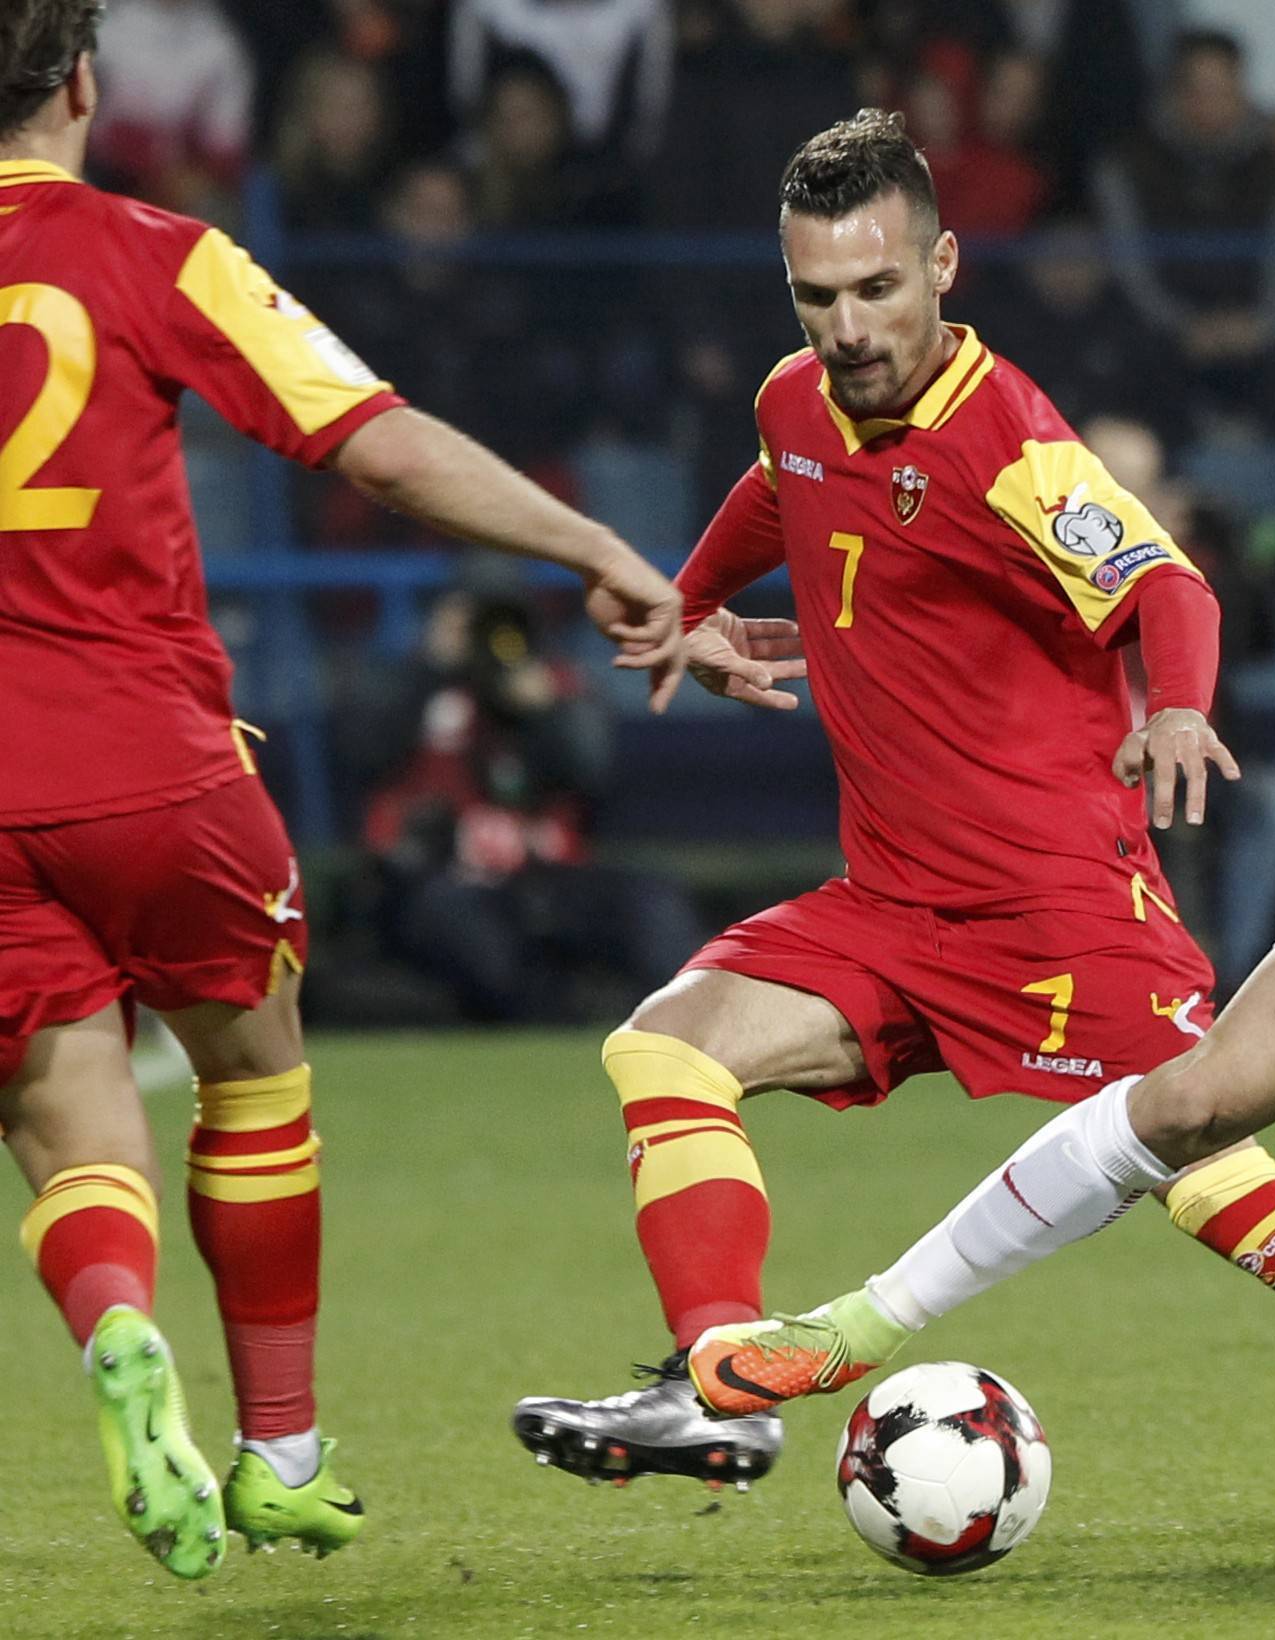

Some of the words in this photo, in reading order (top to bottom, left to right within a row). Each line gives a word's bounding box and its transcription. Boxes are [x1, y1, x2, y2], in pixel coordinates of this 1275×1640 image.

[0, 281, 102, 532] 2
[781, 452, 823, 481] LEGEA
[828, 531, 865, 629] 7
[1115, 547, 1165, 570] RESPEC
[1020, 972, 1075, 1054] 7
[1021, 1051, 1103, 1078] LEGEA
